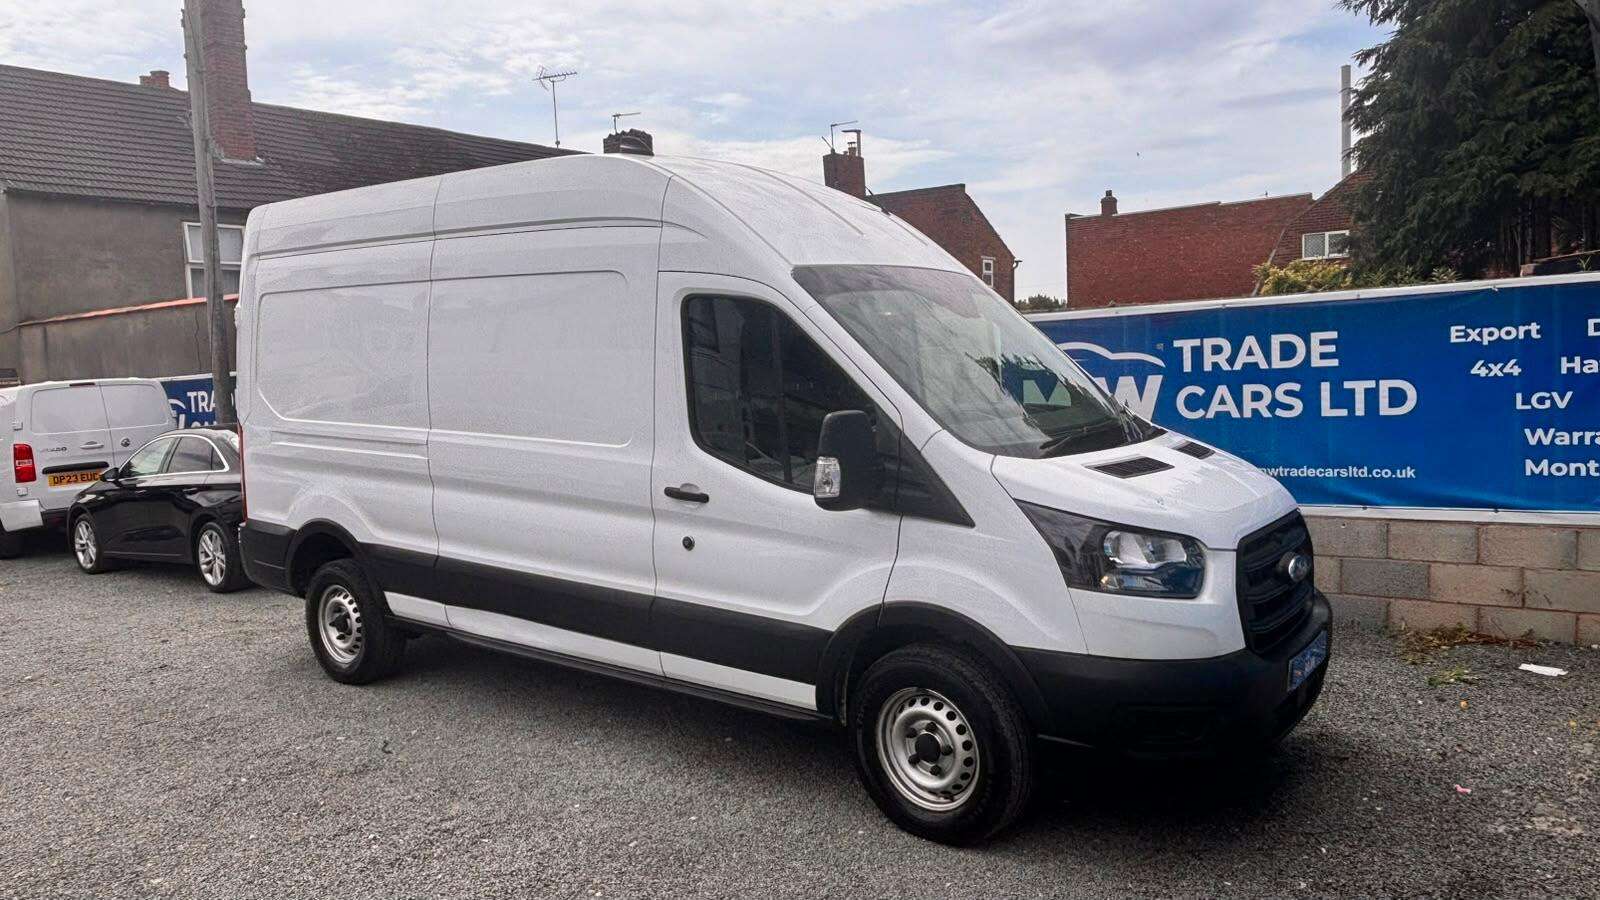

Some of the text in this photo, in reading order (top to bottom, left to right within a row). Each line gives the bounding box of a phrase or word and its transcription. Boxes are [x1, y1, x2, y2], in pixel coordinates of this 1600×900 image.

[1450, 322, 1541, 345] Export
[1173, 331, 1339, 373] TRADE
[1470, 359, 1522, 377] 4x4
[1560, 356, 1600, 374] Ha
[1175, 379, 1418, 420] CARS LTD
[1515, 391, 1573, 410] LGV
